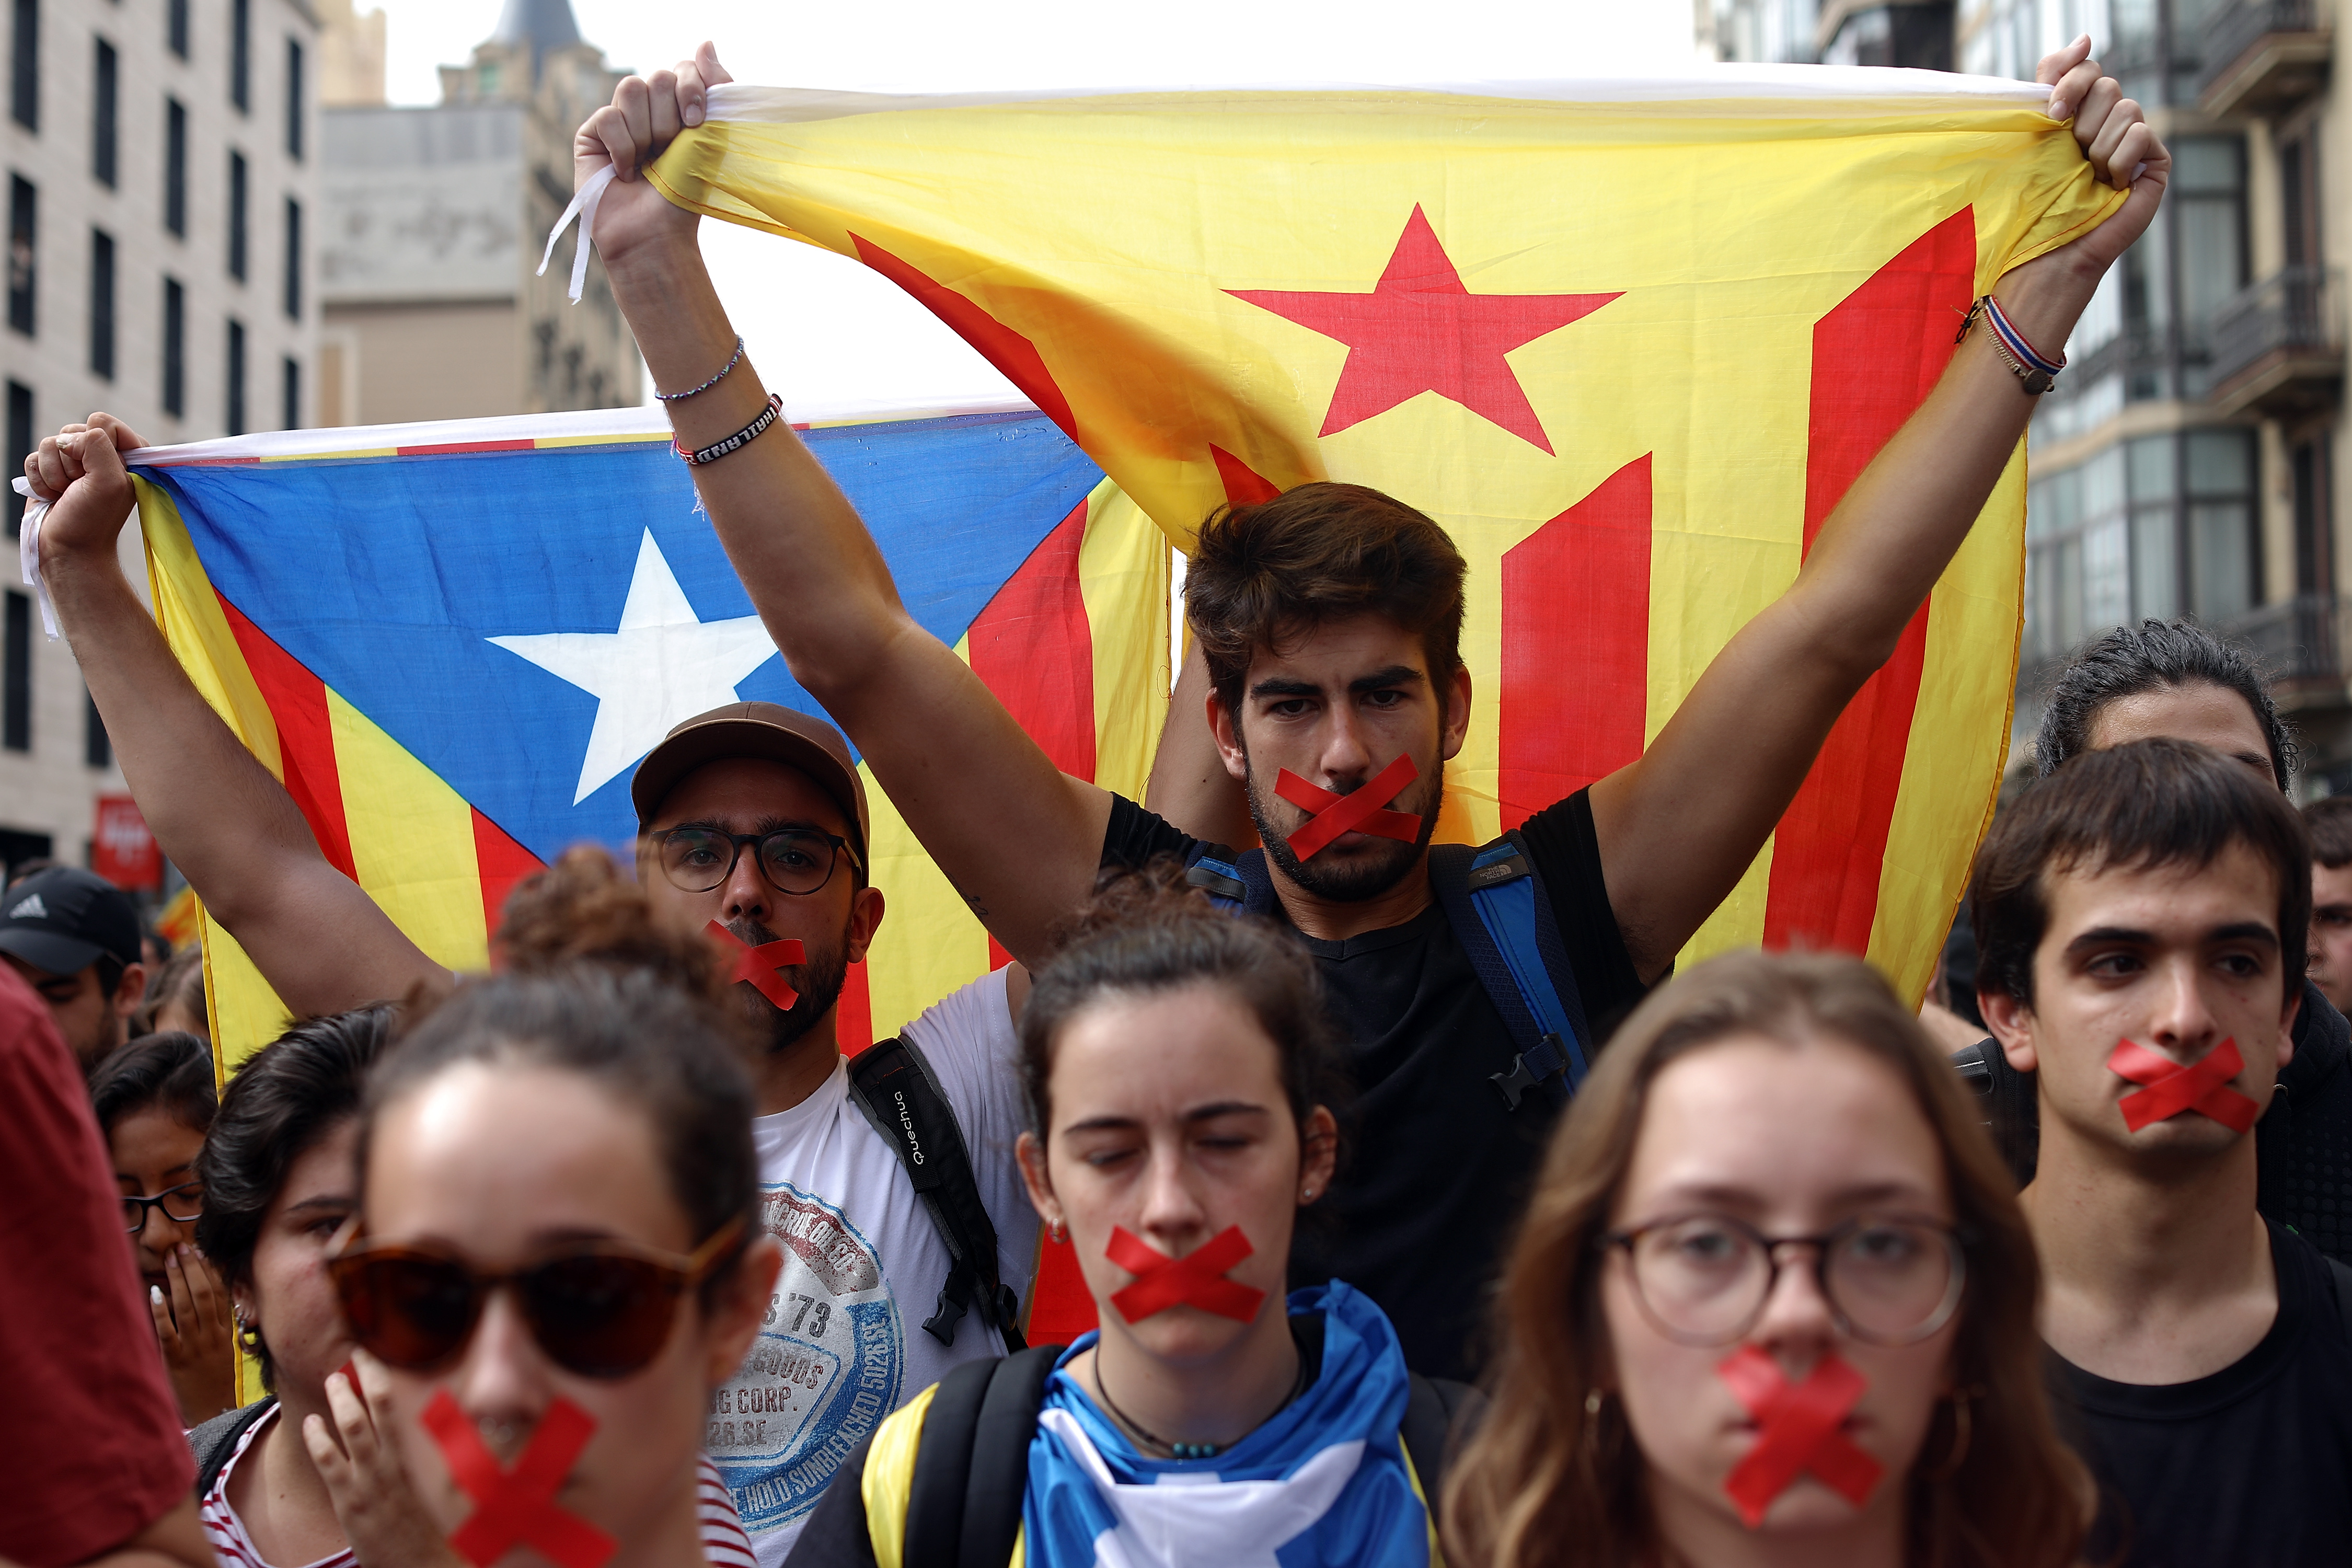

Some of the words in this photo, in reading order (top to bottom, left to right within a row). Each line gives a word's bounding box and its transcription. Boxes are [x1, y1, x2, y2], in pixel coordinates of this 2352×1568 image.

[697, 407, 778, 463] THAILAND
[895, 1091, 925, 1165] Quechua
[809, 1220, 839, 1254] OIL
[762, 1293, 780, 1325] S
[789, 1293, 832, 1338] '73
[754, 1347, 824, 1390] GOODS
[737, 1386, 798, 1414] CORP.
[709, 1420, 767, 1446] 26.SE
[744, 1476, 792, 1513] HOLD
[789, 1392, 882, 1495] SUNBLEACHED
